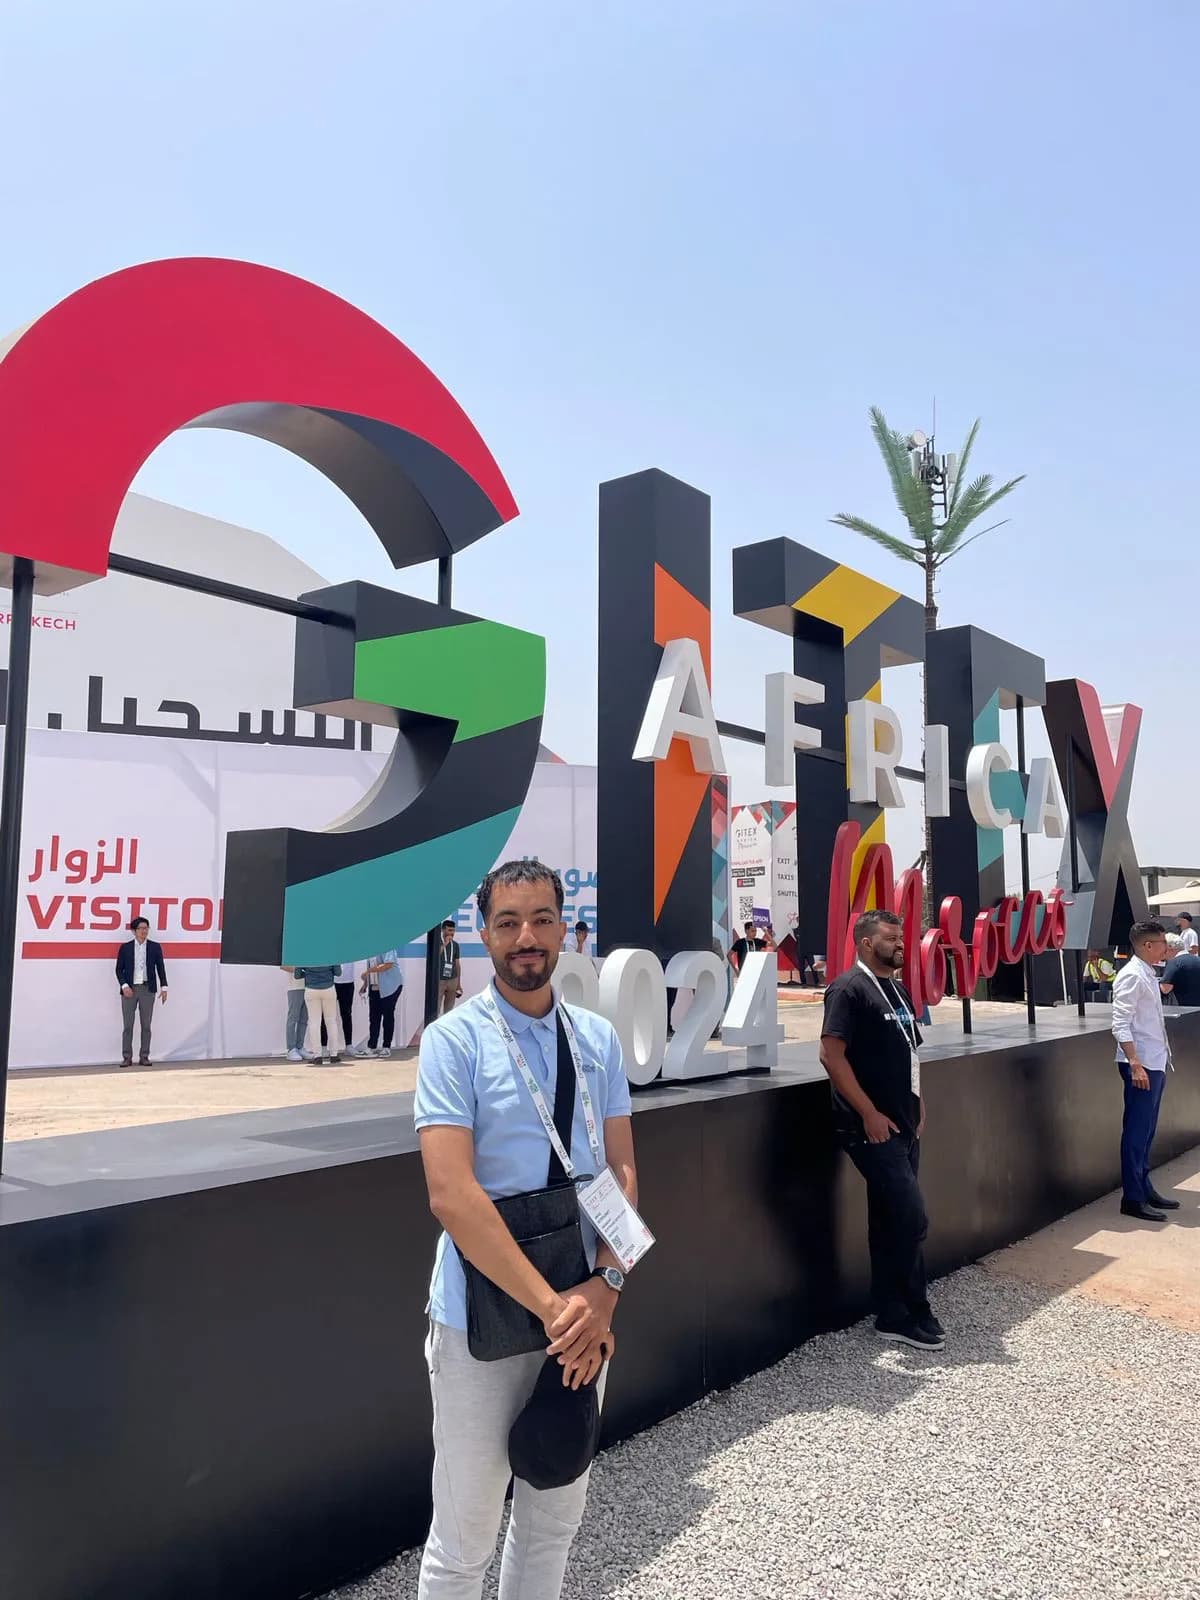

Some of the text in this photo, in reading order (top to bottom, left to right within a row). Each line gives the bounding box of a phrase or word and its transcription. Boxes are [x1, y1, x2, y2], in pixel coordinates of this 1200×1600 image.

[0, 256, 1148, 966] GITEX
[631, 637, 1068, 837] AFRICA
[27, 895, 223, 931] VISITO
[28, 835, 138, 885] الزوار
[826, 820, 1074, 1019] Morocco
